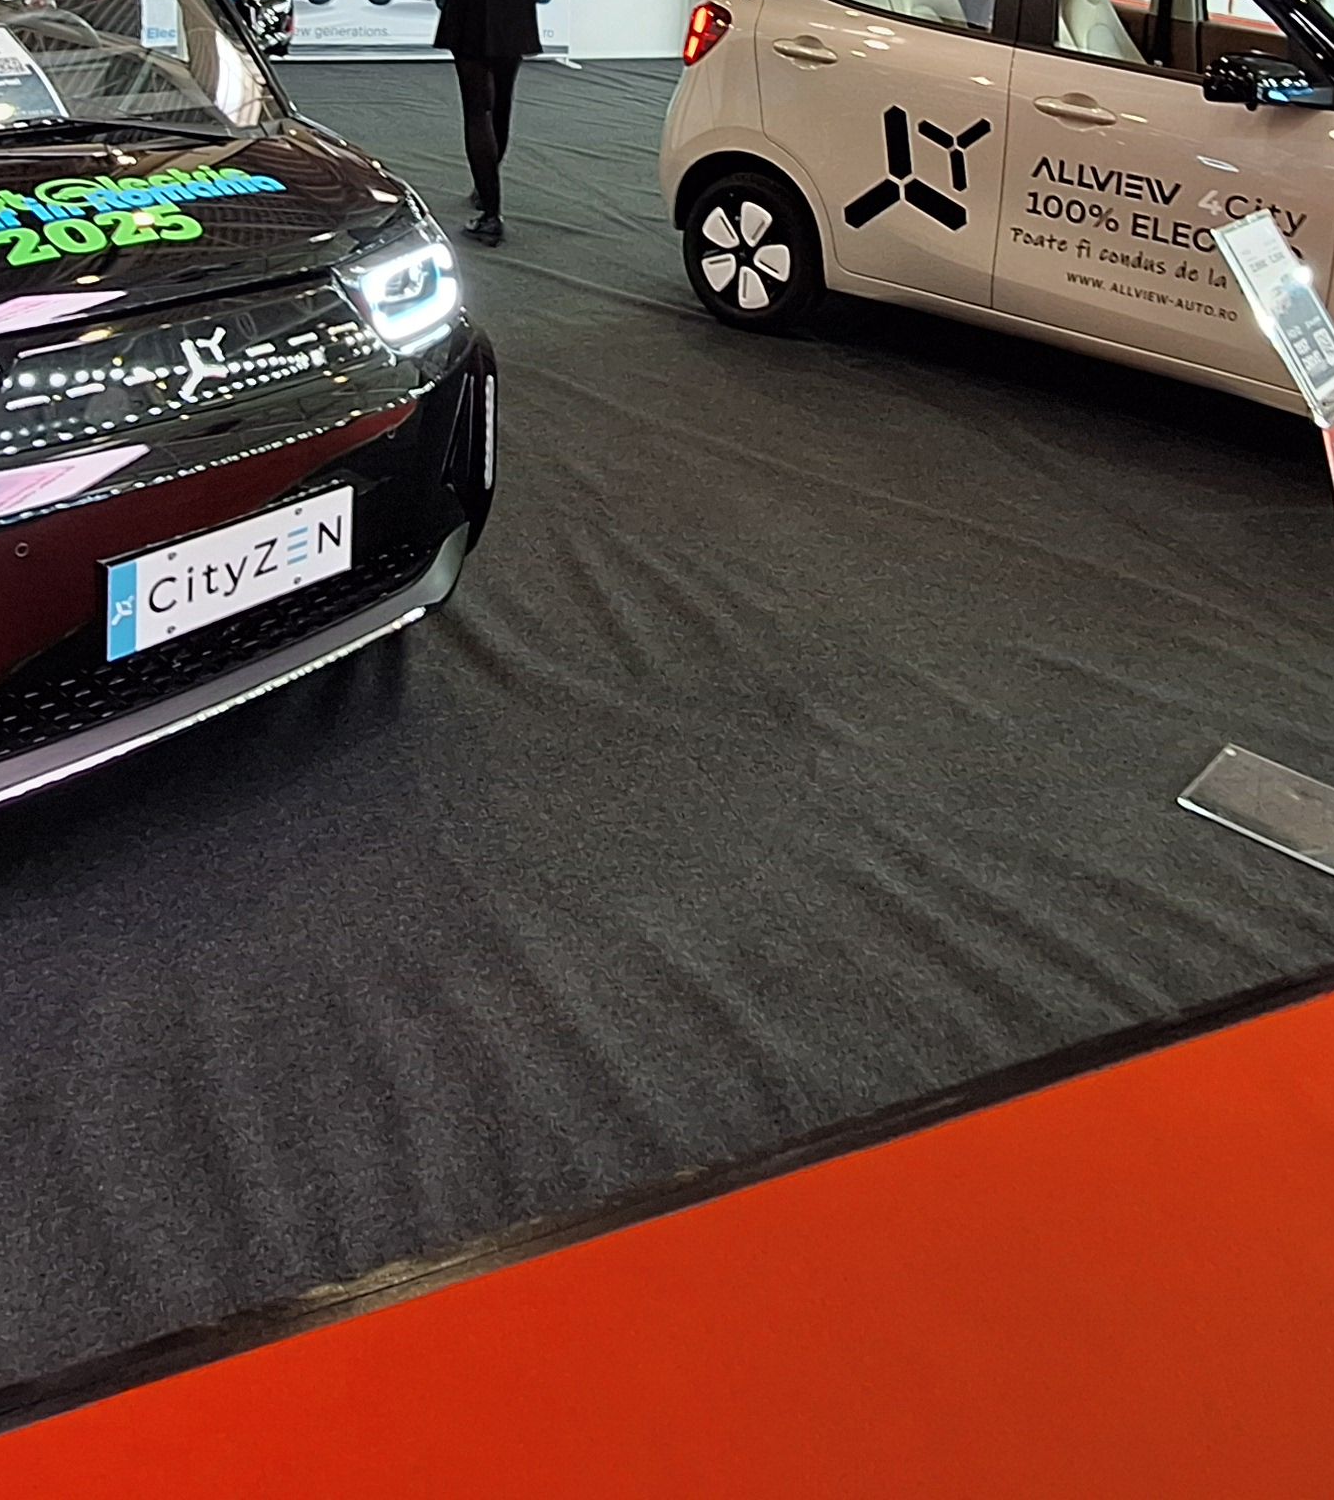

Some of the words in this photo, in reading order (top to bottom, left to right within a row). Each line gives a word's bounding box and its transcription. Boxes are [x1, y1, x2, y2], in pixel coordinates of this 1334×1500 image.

[315, 26, 391, 39] generations.
[1032, 157, 1181, 205] ALLVIEW
[27, 197, 85, 222] in
[1026, 192, 1119, 232] 100%
[1010, 227, 1068, 252] Poate
[1075, 239, 1092, 260] fi
[1099, 246, 1167, 276] condus
[1175, 261, 1199, 282] de
[1208, 268, 1227, 290] la
[148, 515, 342, 614] CityZEN
